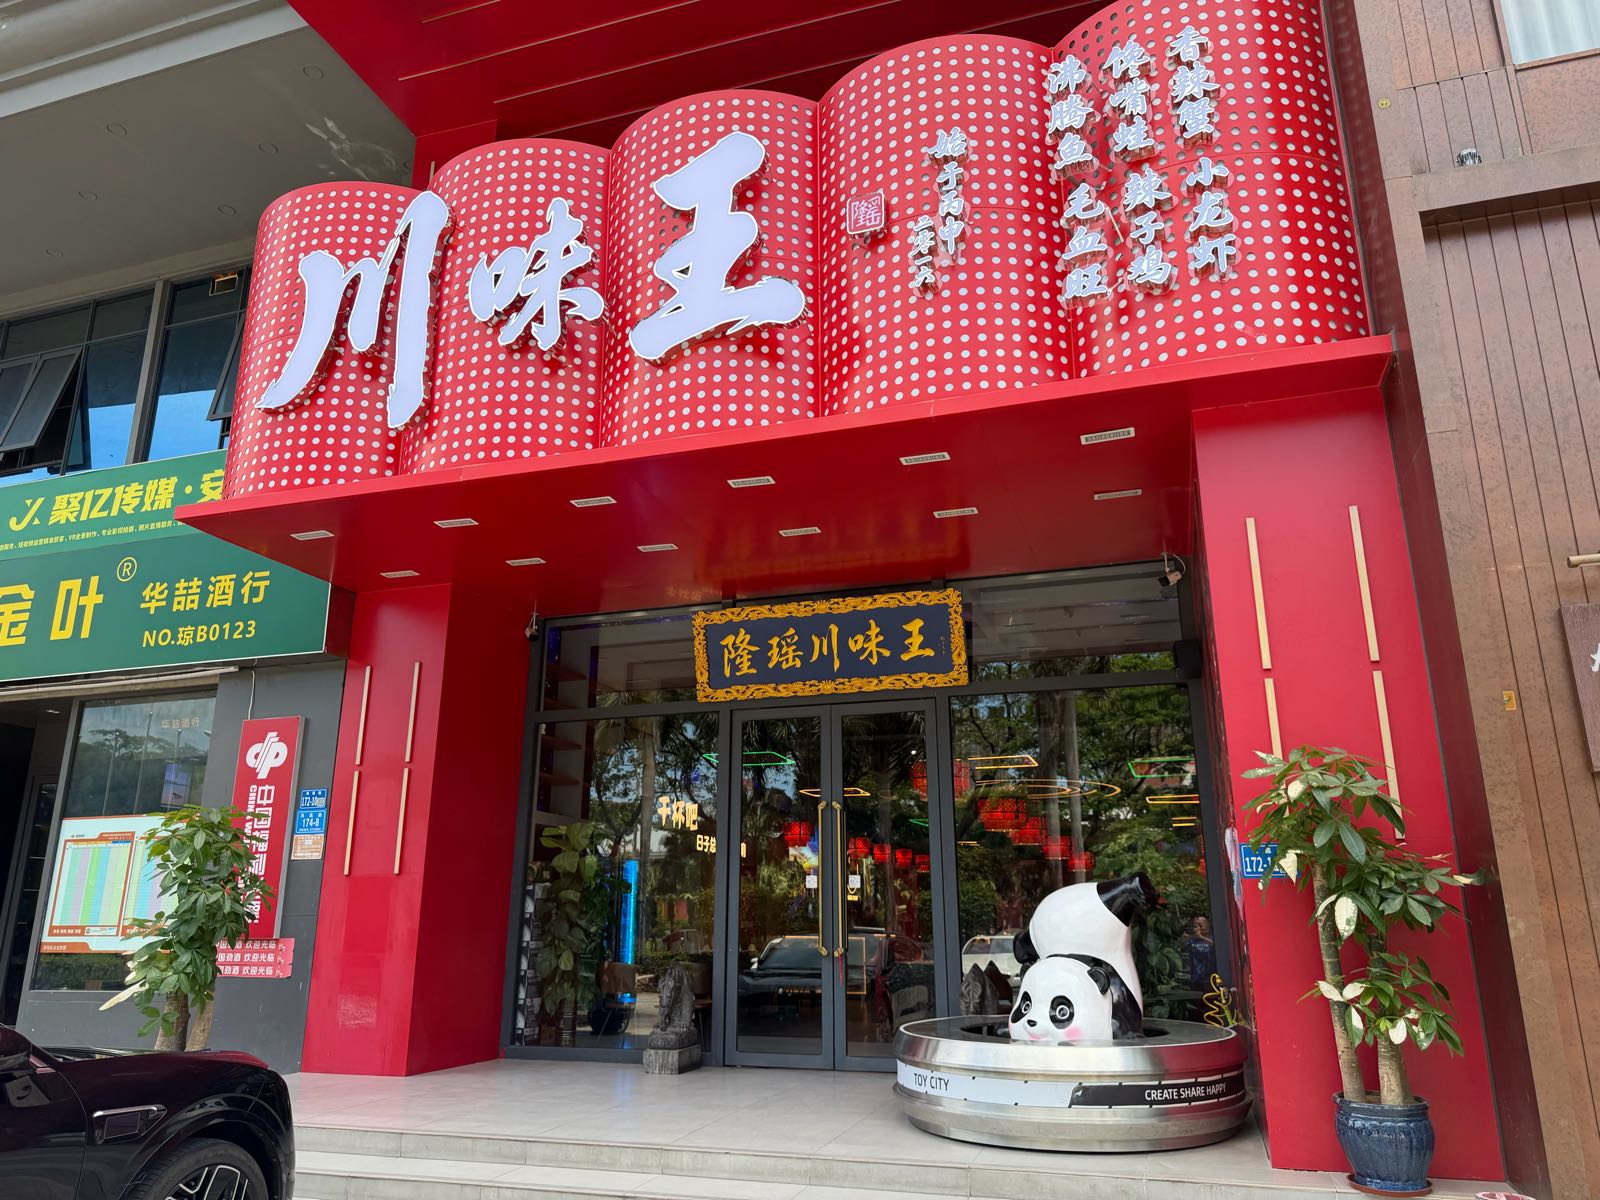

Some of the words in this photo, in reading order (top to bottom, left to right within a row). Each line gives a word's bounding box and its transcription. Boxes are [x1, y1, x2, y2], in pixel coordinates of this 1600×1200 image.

[1048, 55, 1094, 171] 沸腾鱼
[1103, 39, 1156, 153] 馋嘴蛙
[1168, 25, 1221, 139] 香辣蟹
[927, 126, 966, 255] 始于丙申
[1121, 167, 1172, 284] 辣子鸡
[1186, 157, 1237, 272] 小龙虾
[911, 215, 935, 287] 二零一六
[1061, 183, 1107, 299] 毛血旺
[255, 131, 805, 429] 川味王
[140, 570, 271, 615] 华喆酒行
[142, 619, 257, 647] NO.琼B0123
[719, 617, 936, 679] 隆瑶川味王
[302, 817, 320, 828] 174-8
[242, 965, 274, 975] 欢迎光临
[243, 952, 275, 962] 欢迎光临
[913, 1072, 928, 1088] TOY
[930, 1076, 950, 1091] CITY
[1144, 1088, 1179, 1101] CREATE
[1180, 1086, 1205, 1099] SHARE
[1206, 1083, 1227, 1096] HAPPY
